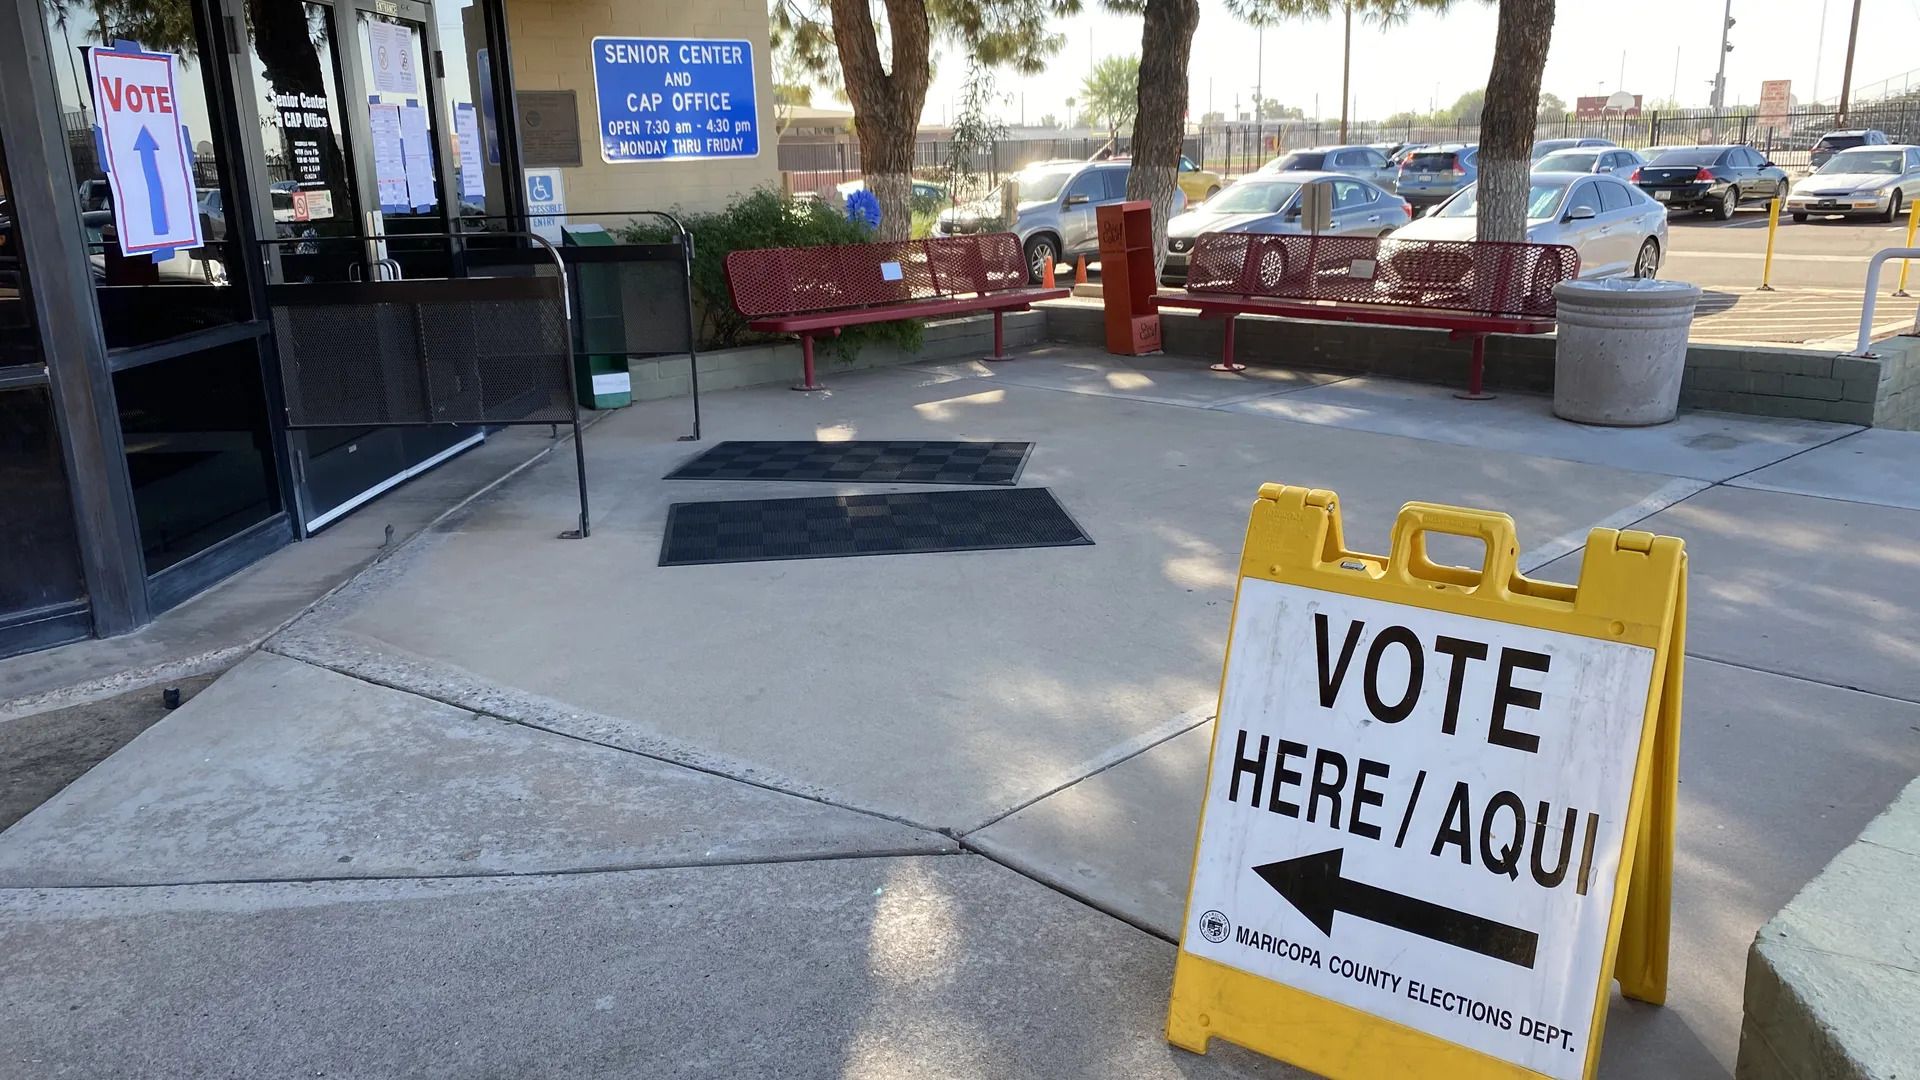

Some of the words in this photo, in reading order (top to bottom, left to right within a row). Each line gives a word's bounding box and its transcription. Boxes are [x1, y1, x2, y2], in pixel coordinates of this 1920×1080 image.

[605, 44, 670, 64] SENIOR
[679, 45, 743, 64] CENTER
[664, 71, 692, 87] AND
[101, 76, 172, 113] VOTE
[270, 90, 299, 108] Senior
[300, 92, 326, 109] Center
[626, 93, 662, 112] CAP
[672, 92, 731, 111] OFFICE
[284, 111, 301, 128] CAP
[303, 112, 328, 128] Office
[608, 121, 640, 136] OPEN
[645, 120, 670, 135] 7:30
[675, 122, 692, 134] am
[706, 119, 729, 133] 4:30
[735, 120, 751, 135] pm
[619, 140, 667, 155] MONDAY
[672, 139, 701, 154] THRU
[706, 138, 743, 152] FRIDAY
[528, 203, 563, 214] CCESSIBLE
[533, 217, 556, 228] ENTRY
[1315, 613, 1551, 753] VOTE
[1236, 926, 1321, 968] MARICOPA
[1329, 956, 1402, 992] COUNTY
[1408, 981, 1513, 1030] ELECTIONS
[1519, 1017, 1576, 1053] DEPT.
